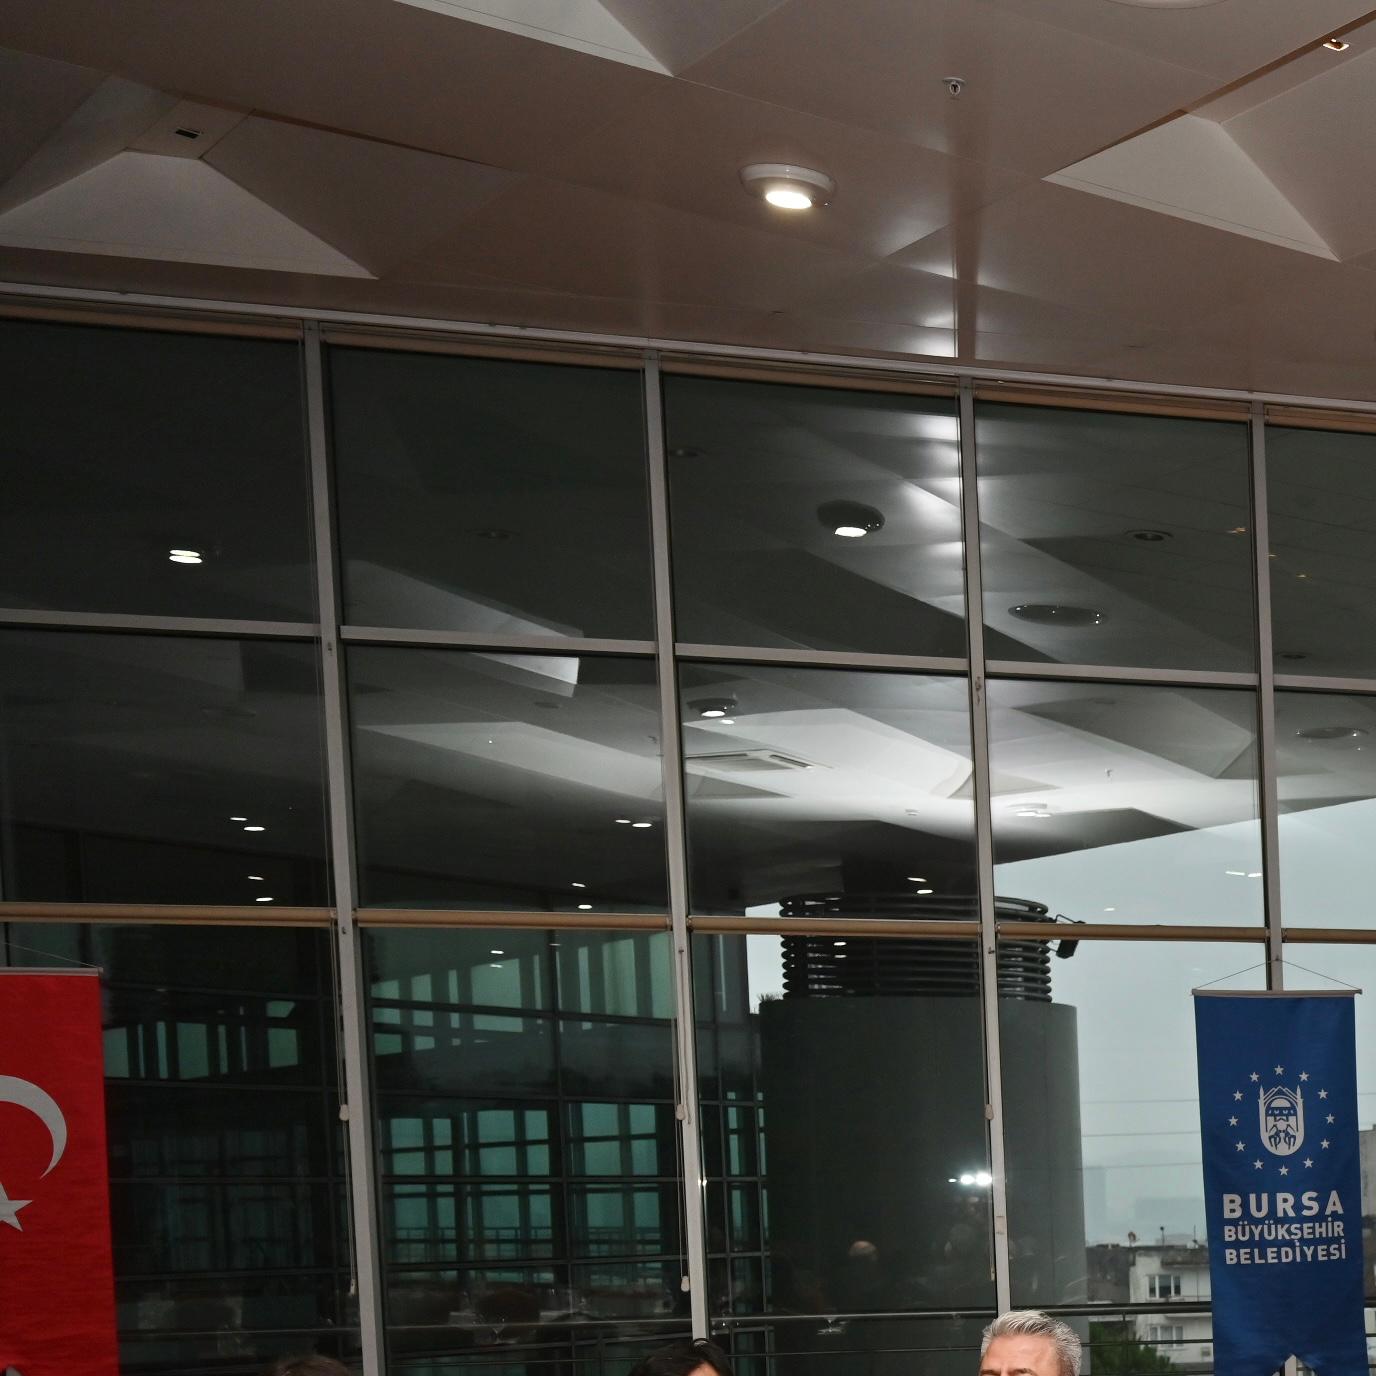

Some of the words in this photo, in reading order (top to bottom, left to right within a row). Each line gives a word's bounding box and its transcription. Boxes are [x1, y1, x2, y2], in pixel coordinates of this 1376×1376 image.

[1222, 1190, 1344, 1219] BURSA
[1224, 1217, 1345, 1242] BÜYÜKŞEHİR
[1225, 1238, 1346, 1265] BELEDİYESİ
